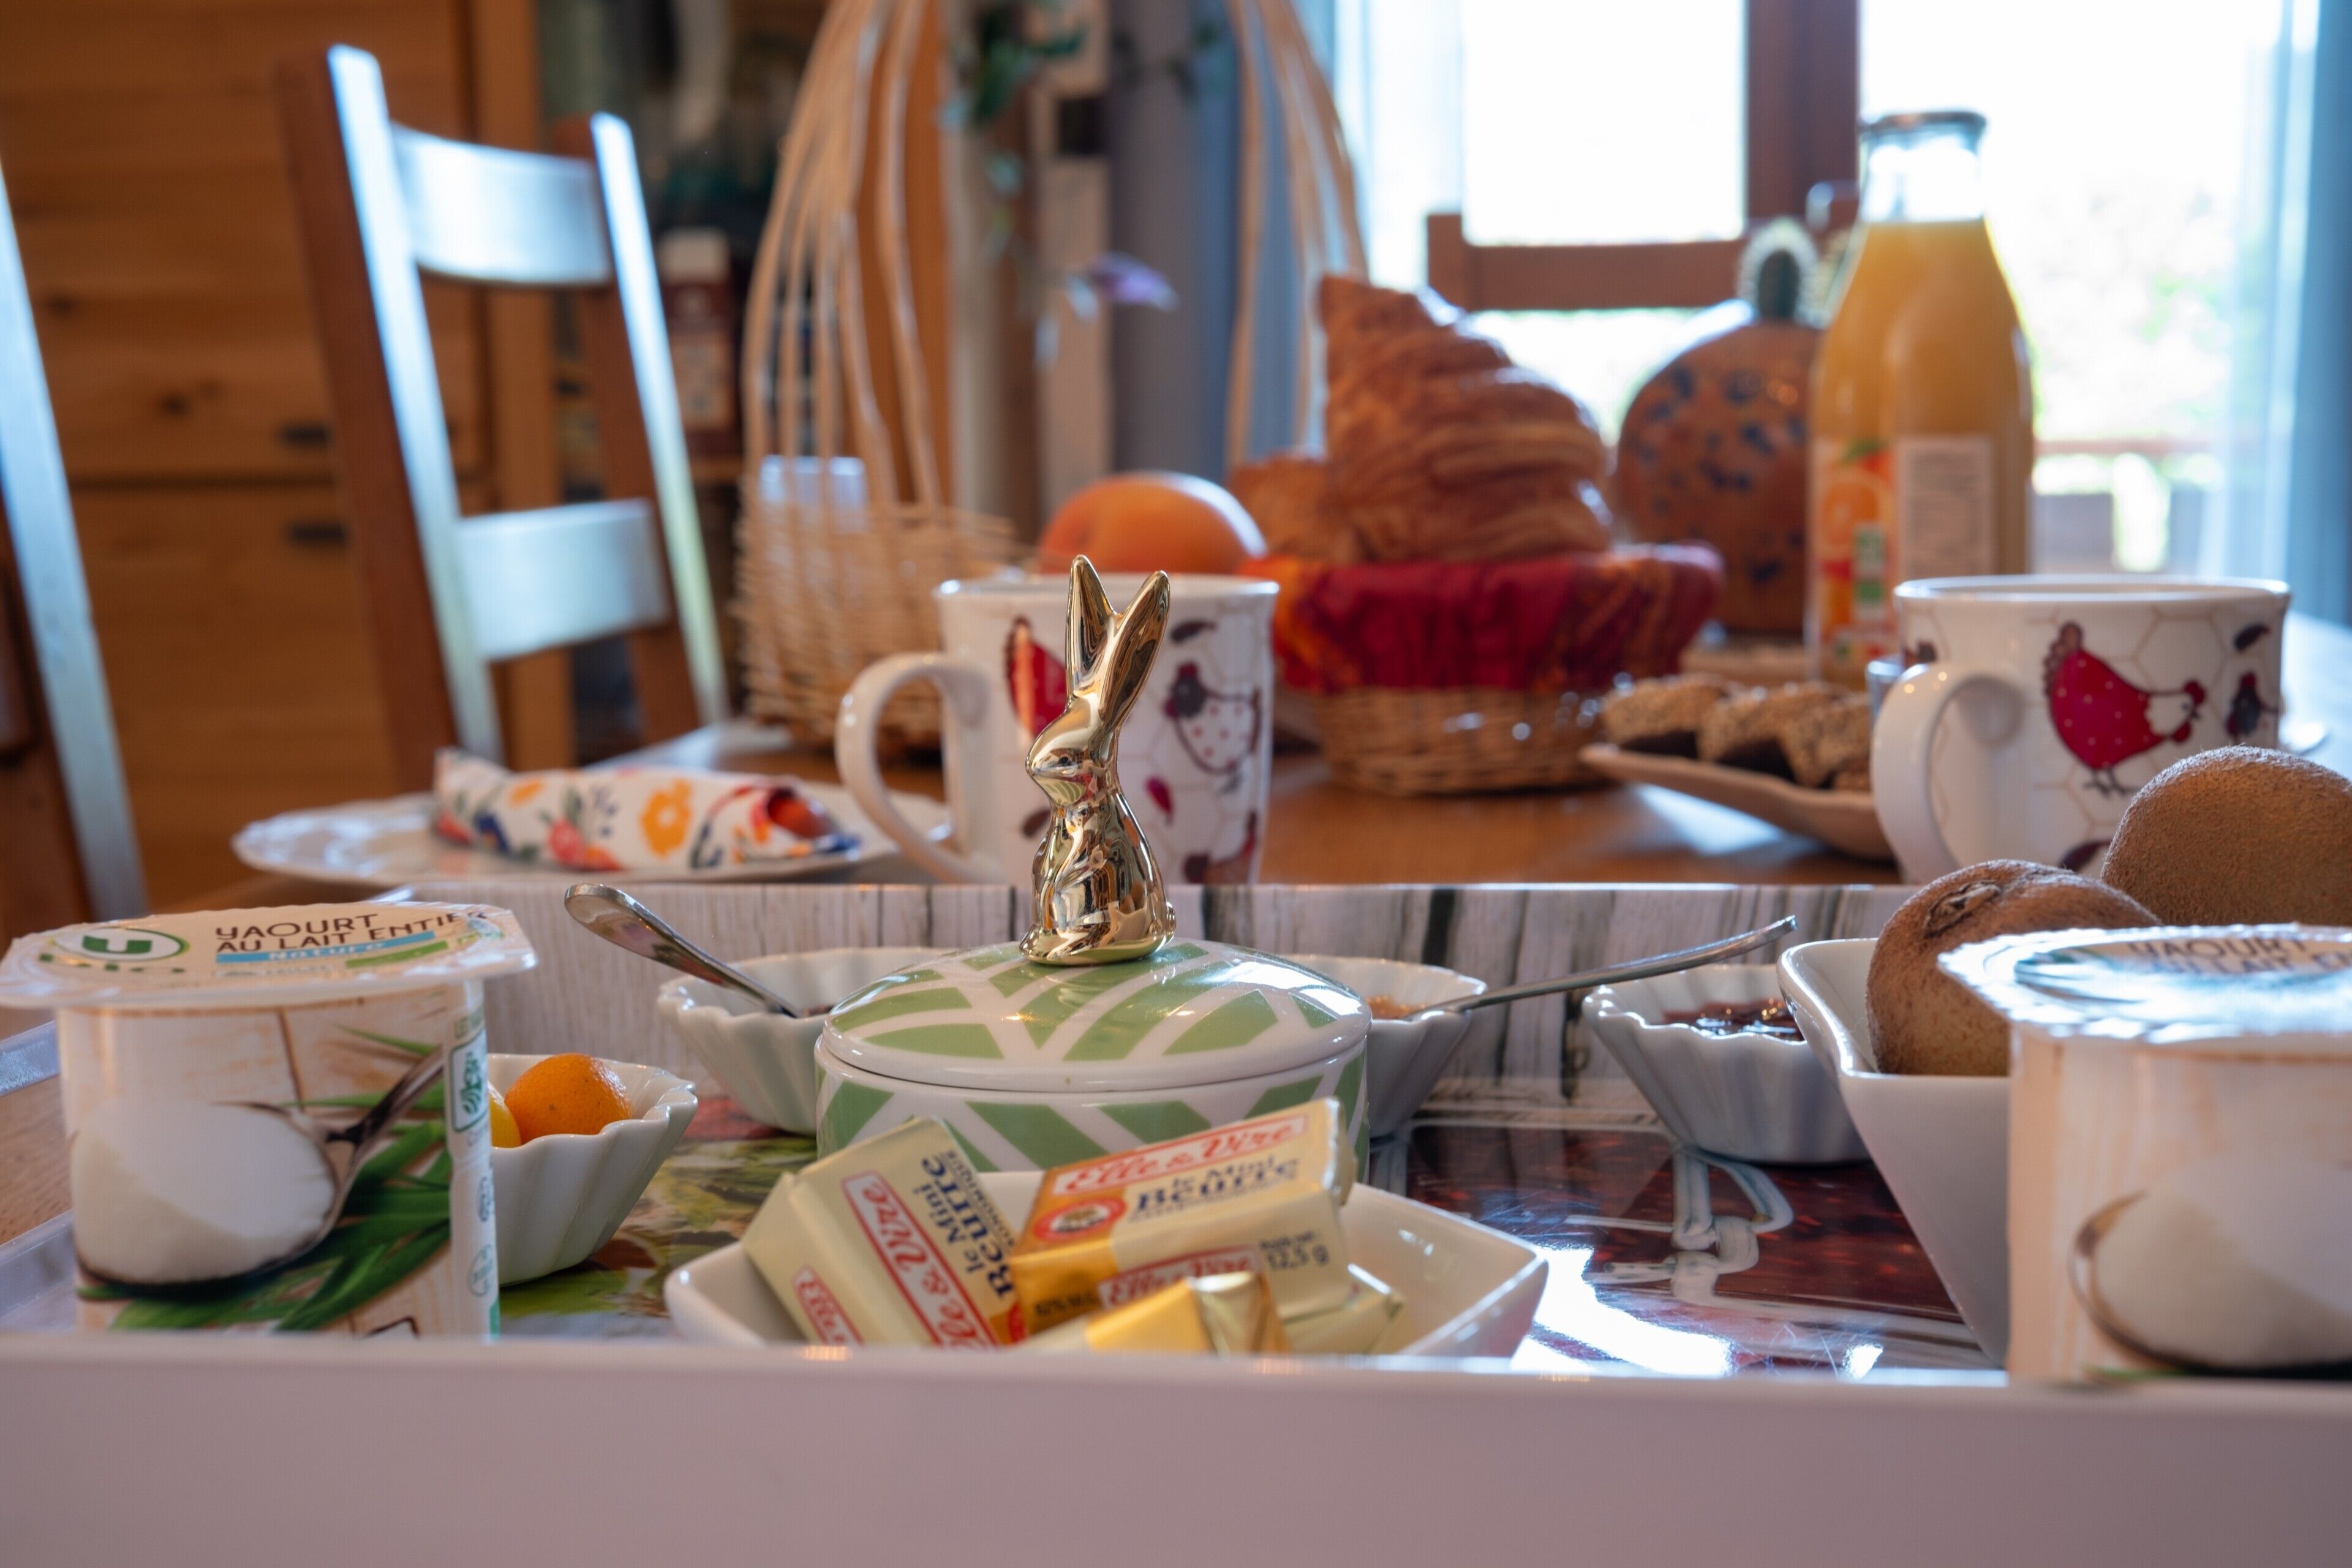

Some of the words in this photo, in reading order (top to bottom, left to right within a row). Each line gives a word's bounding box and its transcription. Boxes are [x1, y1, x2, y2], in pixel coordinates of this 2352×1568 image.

[216, 939, 261, 953] AU
[279, 932, 355, 949] LAIT
[369, 911, 488, 941] ENTIER
[268, 941, 387, 962] Nature
[1065, 1157, 1158, 1191] Elle
[1200, 1125, 1294, 1159] Vire
[1205, 1156, 1275, 1181] Mini
[1136, 1158, 1298, 1212] Beurre
[862, 1181, 929, 1271] Vire
[913, 1182, 967, 1245] Mini
[922, 1157, 1014, 1298] Beurre
[962, 1249, 986, 1273] le
[1312, 1243, 1330, 1266] g
[921, 1265, 951, 1296] &
